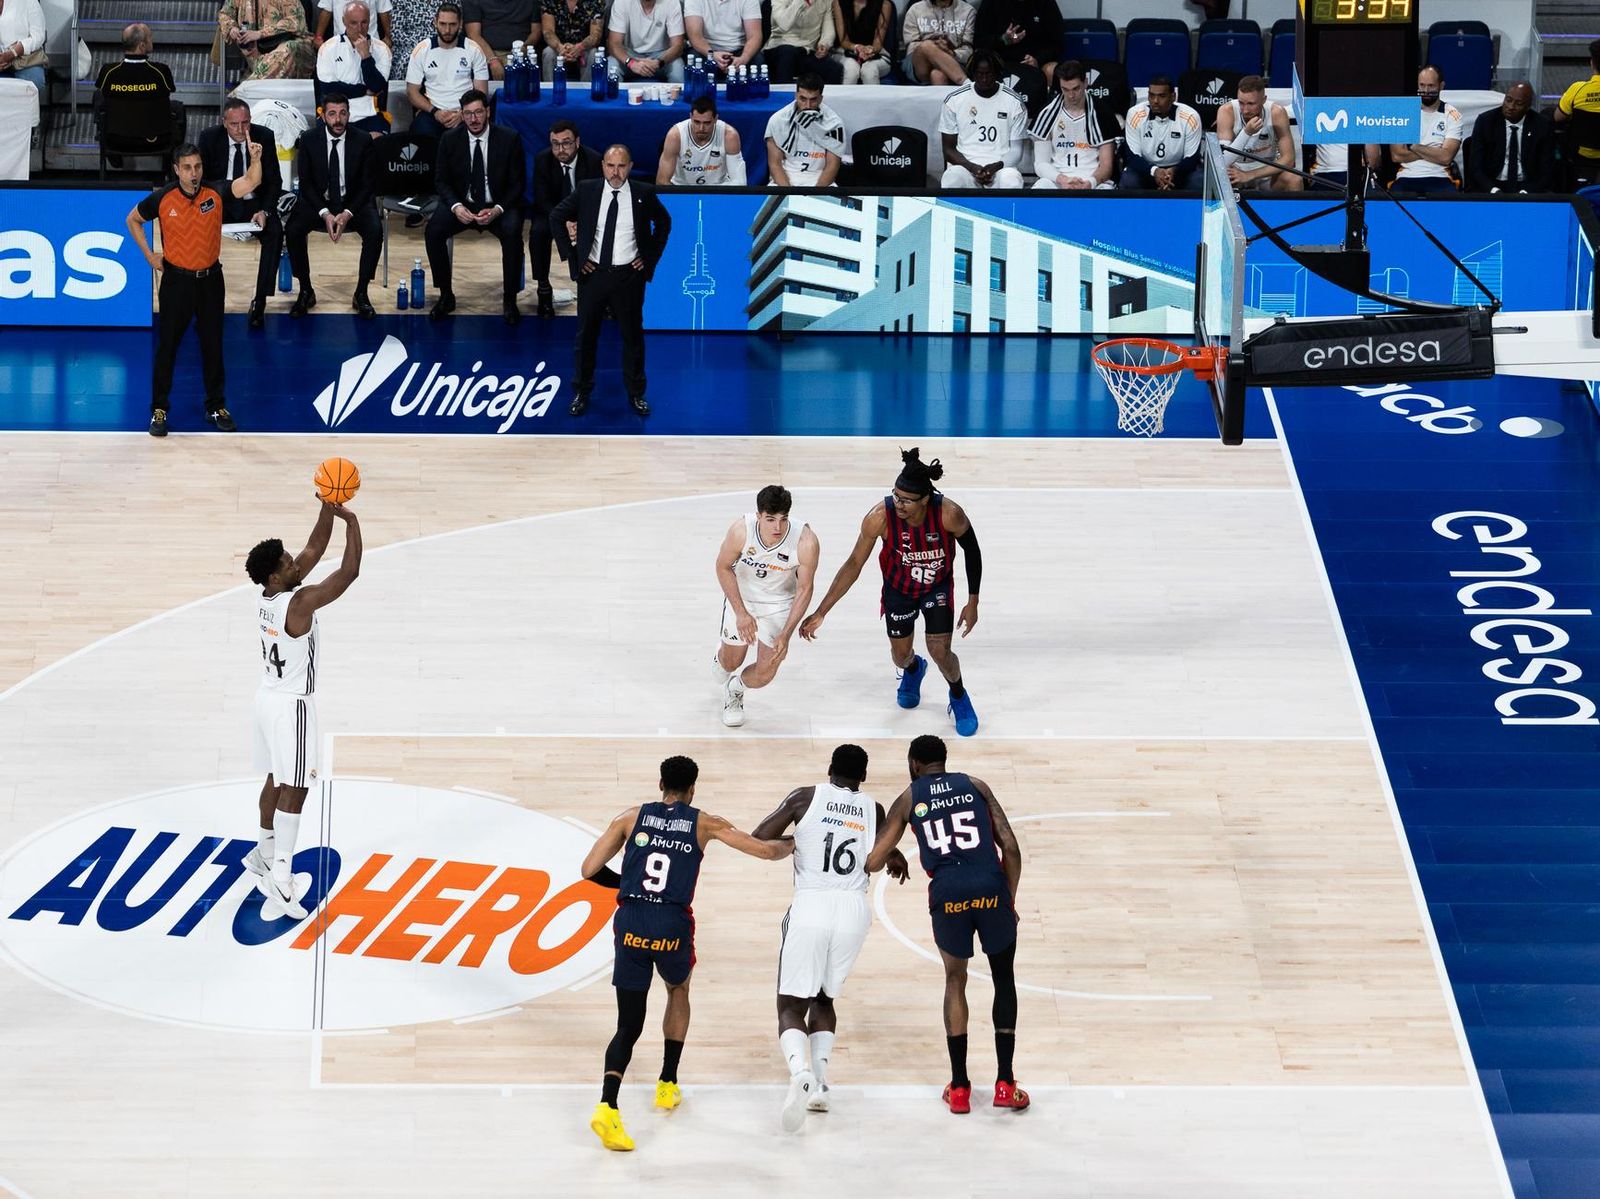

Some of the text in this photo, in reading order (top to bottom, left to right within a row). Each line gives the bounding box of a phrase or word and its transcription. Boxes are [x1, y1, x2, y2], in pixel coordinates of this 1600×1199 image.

[110, 83, 157, 92] PROSEGUR
[1355, 115, 1409, 127] Movistar
[978, 126, 997, 142] 30
[1156, 142, 1165, 158] 8
[388, 161, 430, 174] Unicaja
[870, 155, 912, 168] Unicaja
[1066, 153, 1079, 167] 11
[696, 176, 706, 184] 6
[0, 230, 127, 300] as
[1303, 337, 1440, 368] endesa
[391, 360, 561, 434] Unicaja
[911, 566, 937, 585] 95
[1431, 510, 1600, 725] endesa
[930, 781, 953, 795] HALL
[826, 801, 864, 818] GARUBA
[930, 794, 974, 811] AMUTIO
[821, 816, 865, 832] AUTOHERO
[922, 810, 981, 855] 45
[650, 837, 693, 853] AMUTIO
[822, 831, 857, 875] 16
[642, 852, 671, 893] 9
[8, 826, 619, 975] AUTOHERO
